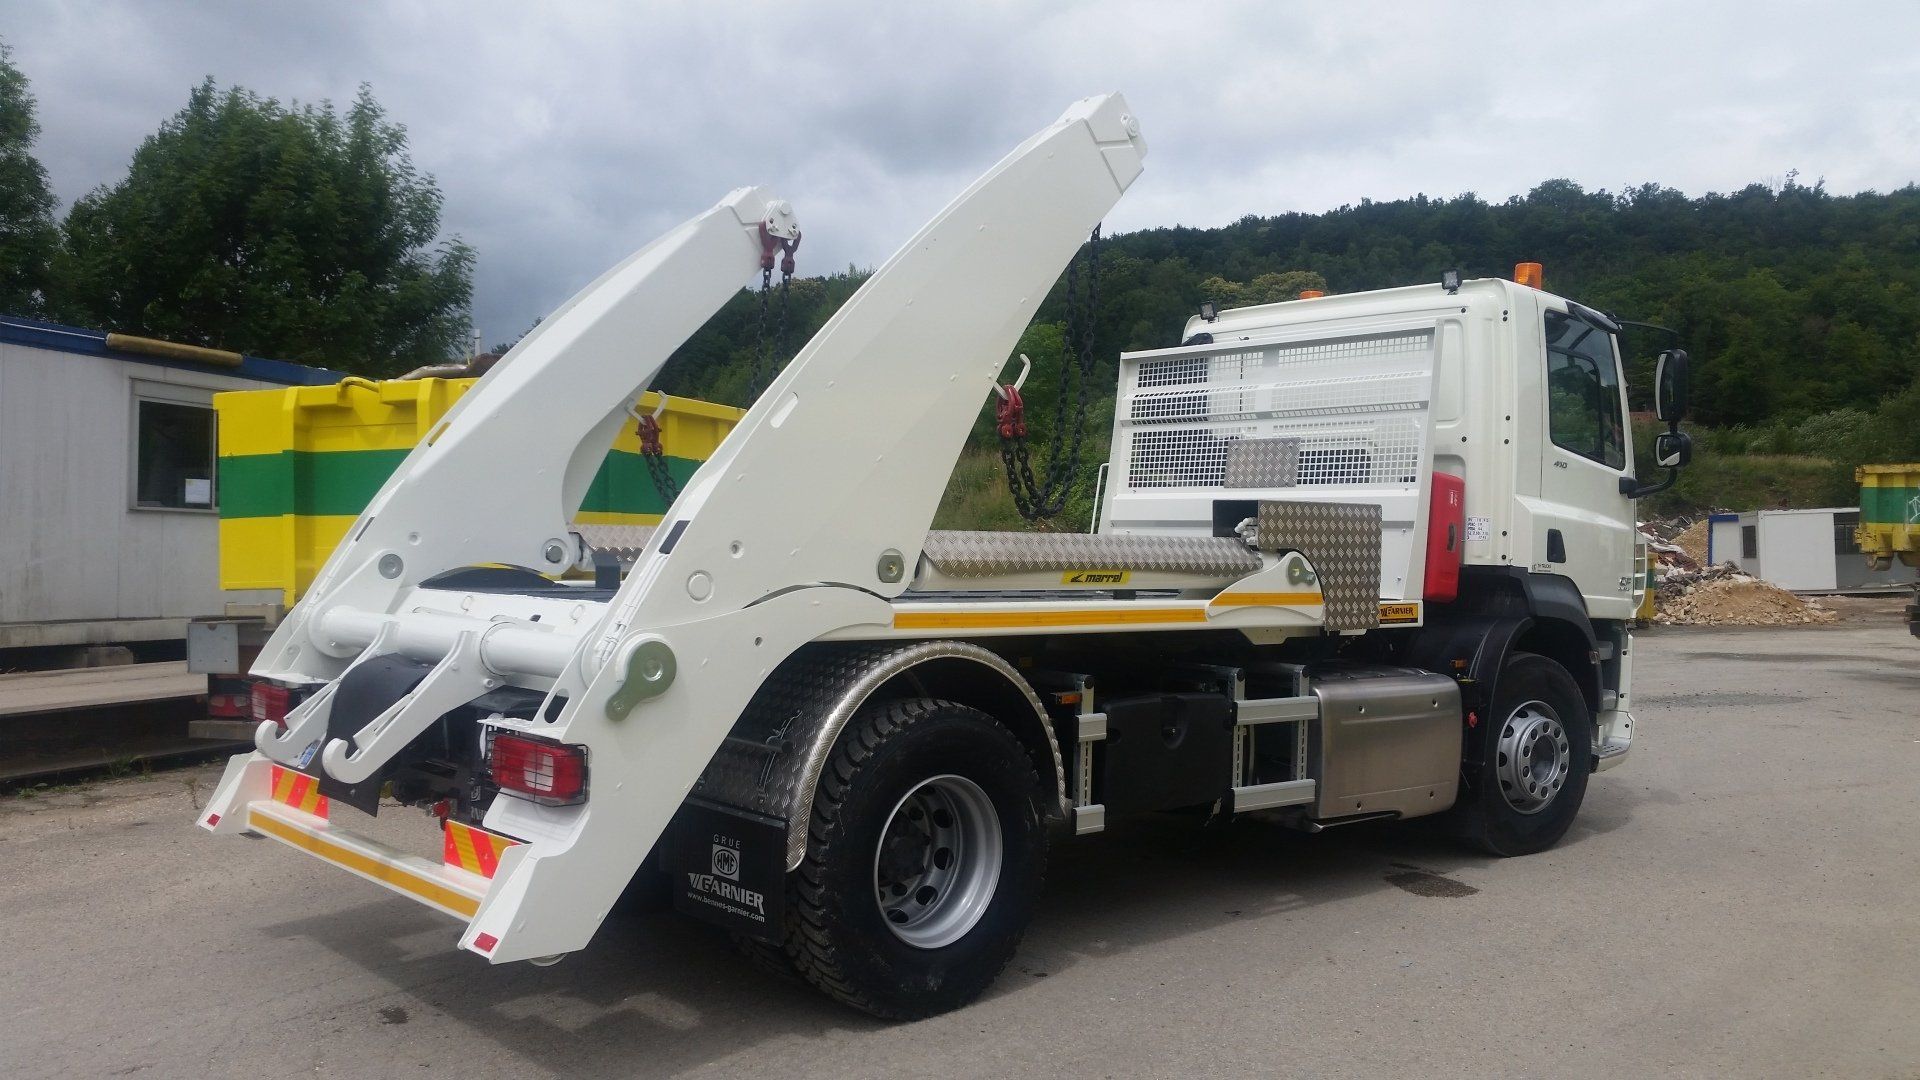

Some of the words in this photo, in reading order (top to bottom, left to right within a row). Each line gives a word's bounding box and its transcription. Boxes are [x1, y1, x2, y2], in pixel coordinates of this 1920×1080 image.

[1084, 571, 1123, 583] marrel
[713, 833, 741, 849] GRUE
[715, 850, 736, 874] HMF
